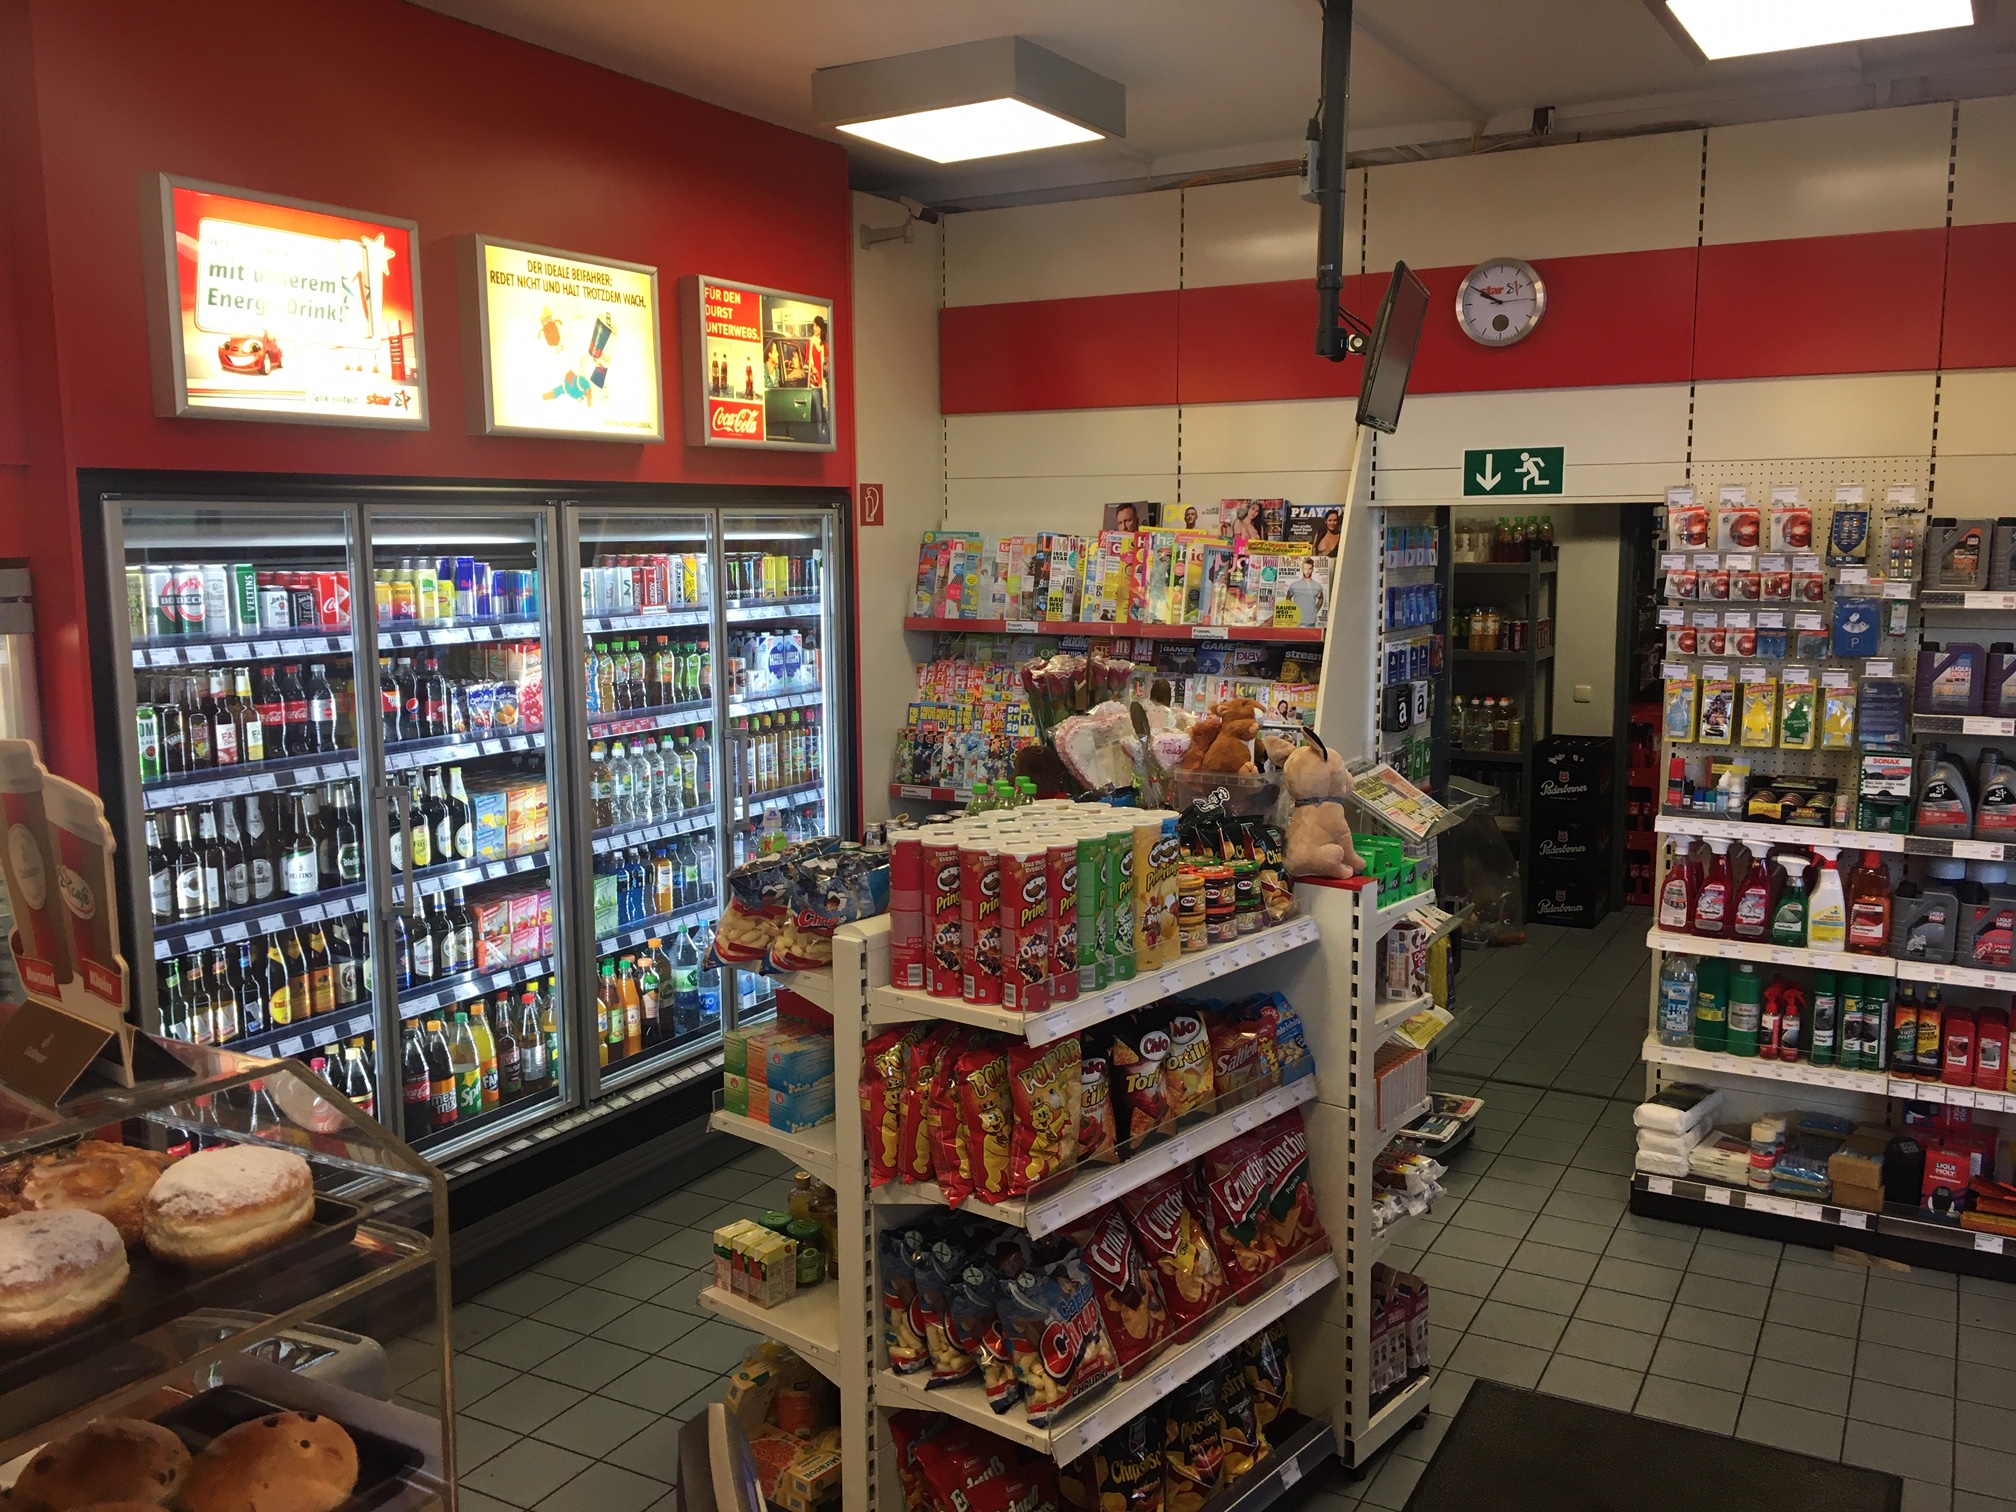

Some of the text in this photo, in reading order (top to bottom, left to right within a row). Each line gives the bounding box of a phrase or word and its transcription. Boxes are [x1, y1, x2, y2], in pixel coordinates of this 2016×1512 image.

[209, 259, 336, 294] mit unserem
[527, 260, 613, 287] DER IDEALE BEIFAHRER:
[489, 269, 514, 287] REDET
[517, 275, 541, 291] NICHT
[543, 280, 560, 294] UND
[583, 285, 622, 304] TROTZDEM
[623, 293, 646, 308] WACH.
[705, 286, 741, 305] FÜR DEN
[287, 298, 343, 323] Drink!
[705, 304, 733, 320] DURST
[706, 324, 760, 341] UNTERWEGS.
[365, 393, 392, 406] star
[712, 406, 759, 434] Coca-Cola
[245, 574, 254, 612] VELTINS
[1851, 638, 1860, 648] P
[1236, 651, 1262, 663] play
[1398, 701, 1408, 724] a
[1416, 693, 1425, 716] a
[1160, 739, 1186, 756] Teddy
[1540, 778, 1588, 796] Paderborner
[1538, 838, 1587, 856] Paderborner
[1536, 897, 1585, 915] Paderborner
[25, 963, 56, 988] Normal
[89, 968, 113, 997] Klein
[1142, 1036, 1170, 1055] Chio
[1935, 1168, 1957, 1177] MOLY
[1936, 1162, 1957, 1170] LIQUI
[1071, 1369, 1109, 1397] CHRUPKI
